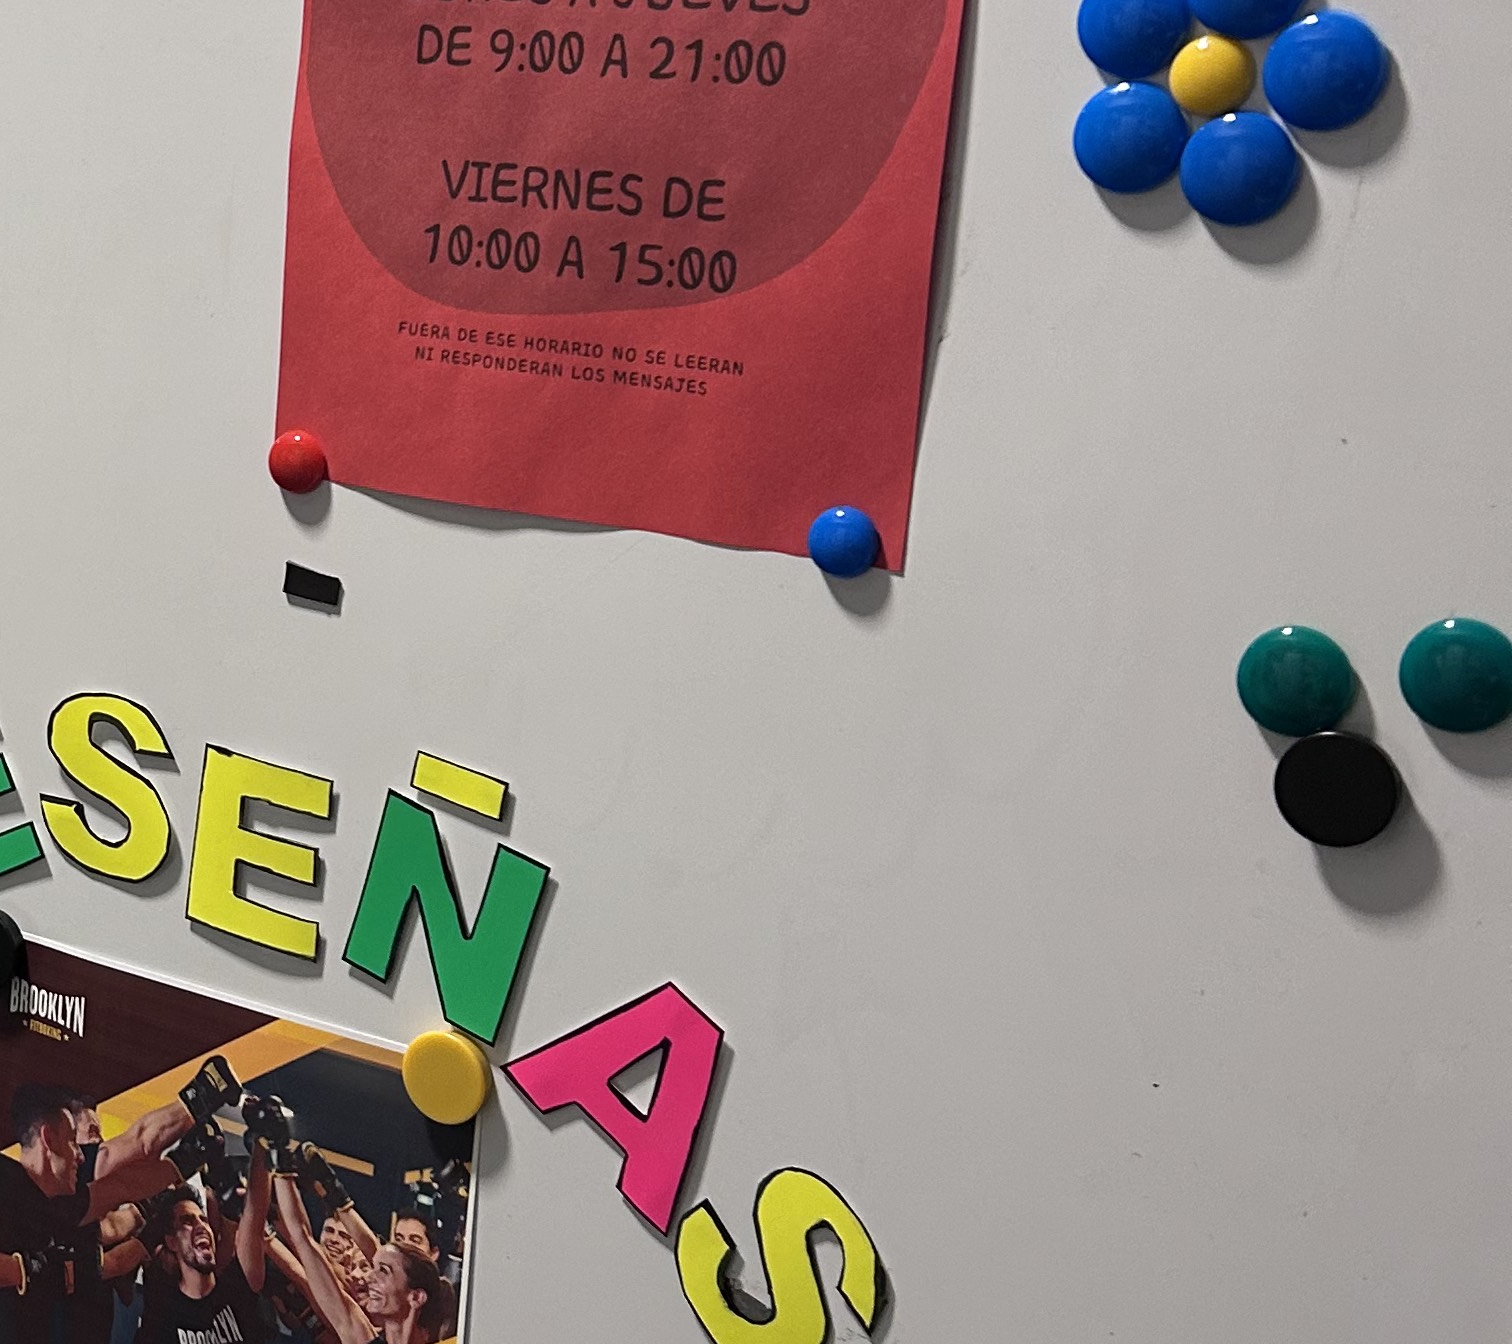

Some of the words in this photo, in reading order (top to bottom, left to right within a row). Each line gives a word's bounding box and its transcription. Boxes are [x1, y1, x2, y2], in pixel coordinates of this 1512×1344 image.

[416, 24, 473, 65] DE
[490, 29, 585, 75] 9:00
[600, 34, 629, 79] A
[648, 37, 787, 87] 21:00
[441, 159, 644, 217] VIERNES
[662, 176, 727, 222] DE
[423, 224, 541, 273] 10:00
[557, 235, 585, 280] A
[609, 242, 737, 293] 15:00
[398, 321, 450, 341] FUERA
[457, 328, 477, 343] DE
[485, 331, 516, 348] ESE
[524, 336, 603, 359] HORARIO
[612, 348, 637, 363] NO
[644, 350, 666, 365] SE
[674, 354, 744, 376] LEERAN
[415, 346, 433, 361] NI
[441, 348, 563, 377] RESPONDERAN
[571, 365, 605, 382] LOS
[613, 370, 708, 396] MENSAJES
[10, 976, 85, 1037] BROOKLYN
